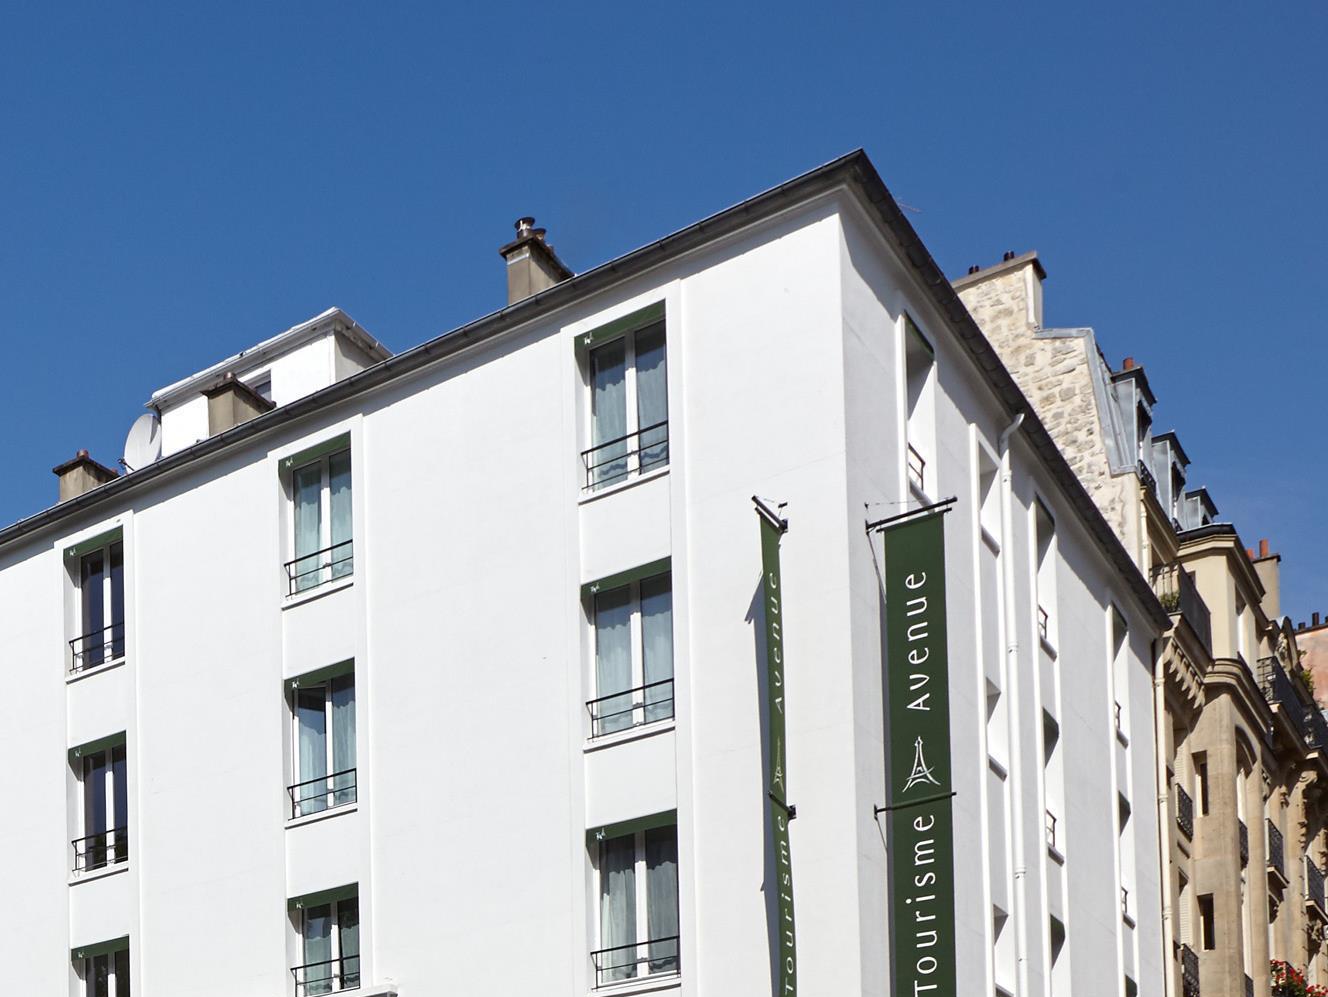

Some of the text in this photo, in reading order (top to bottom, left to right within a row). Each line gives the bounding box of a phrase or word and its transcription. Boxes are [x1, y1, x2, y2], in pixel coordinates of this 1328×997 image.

[905, 571, 931, 711] Avenue
[769, 571, 795, 996] Tourisme Avenue
